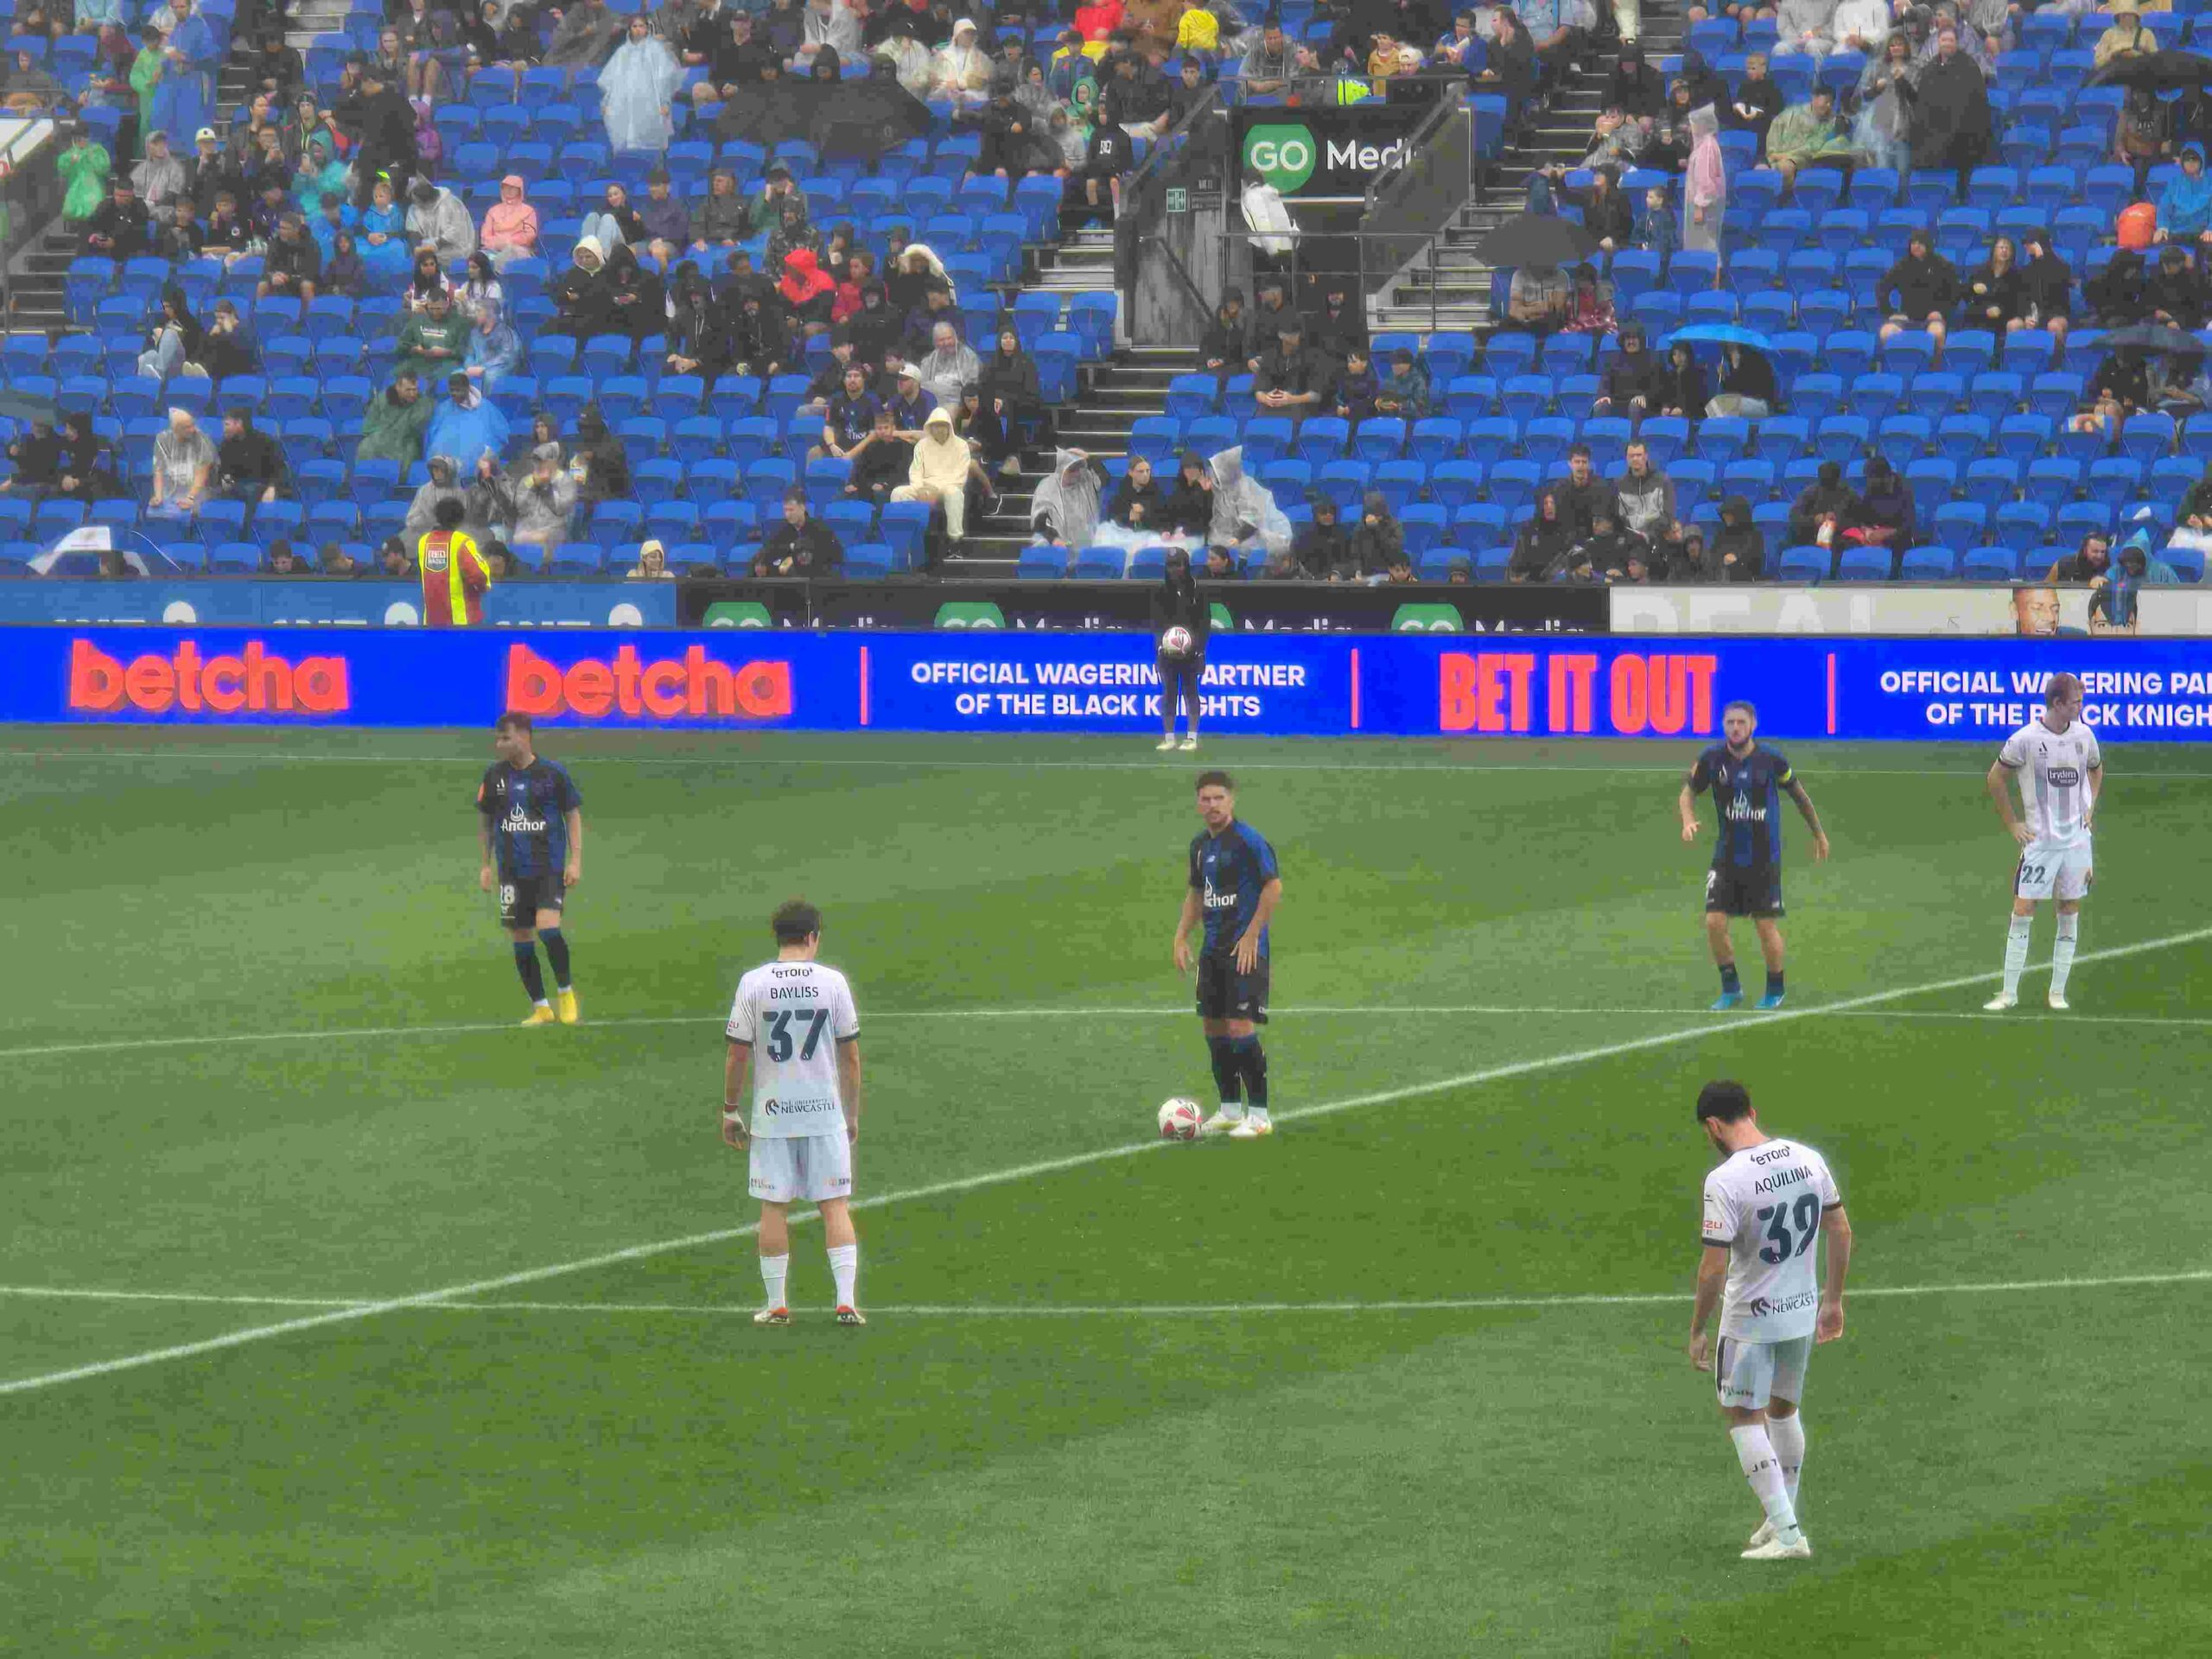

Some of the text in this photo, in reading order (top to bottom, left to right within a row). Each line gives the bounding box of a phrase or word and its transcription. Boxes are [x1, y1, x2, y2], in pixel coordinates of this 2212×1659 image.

[1250, 138, 1415, 171] GO Medi
[70, 639, 349, 712] betcha
[505, 643, 792, 717] betcha
[911, 662, 1306, 686] OFFICIAL WAGERIN ARTNER
[1879, 671, 2005, 693] OFFICIAL
[2011, 671, 2163, 694] WAERING
[955, 693, 1262, 716] OF THE BLACK KIHTS
[1440, 652, 1717, 734] BET IT OUT
[1925, 702, 1964, 725] OF
[1969, 703, 2024, 725] THE
[2030, 703, 2121, 726] BCK
[500, 817, 547, 832] Anchor
[2021, 865, 2046, 884] 22
[770, 986, 819, 1000] BAYLISS
[762, 1008, 830, 1063] 37
[1754, 1165, 1814, 1196] AQUILINA
[1757, 1192, 1820, 1265] 39
